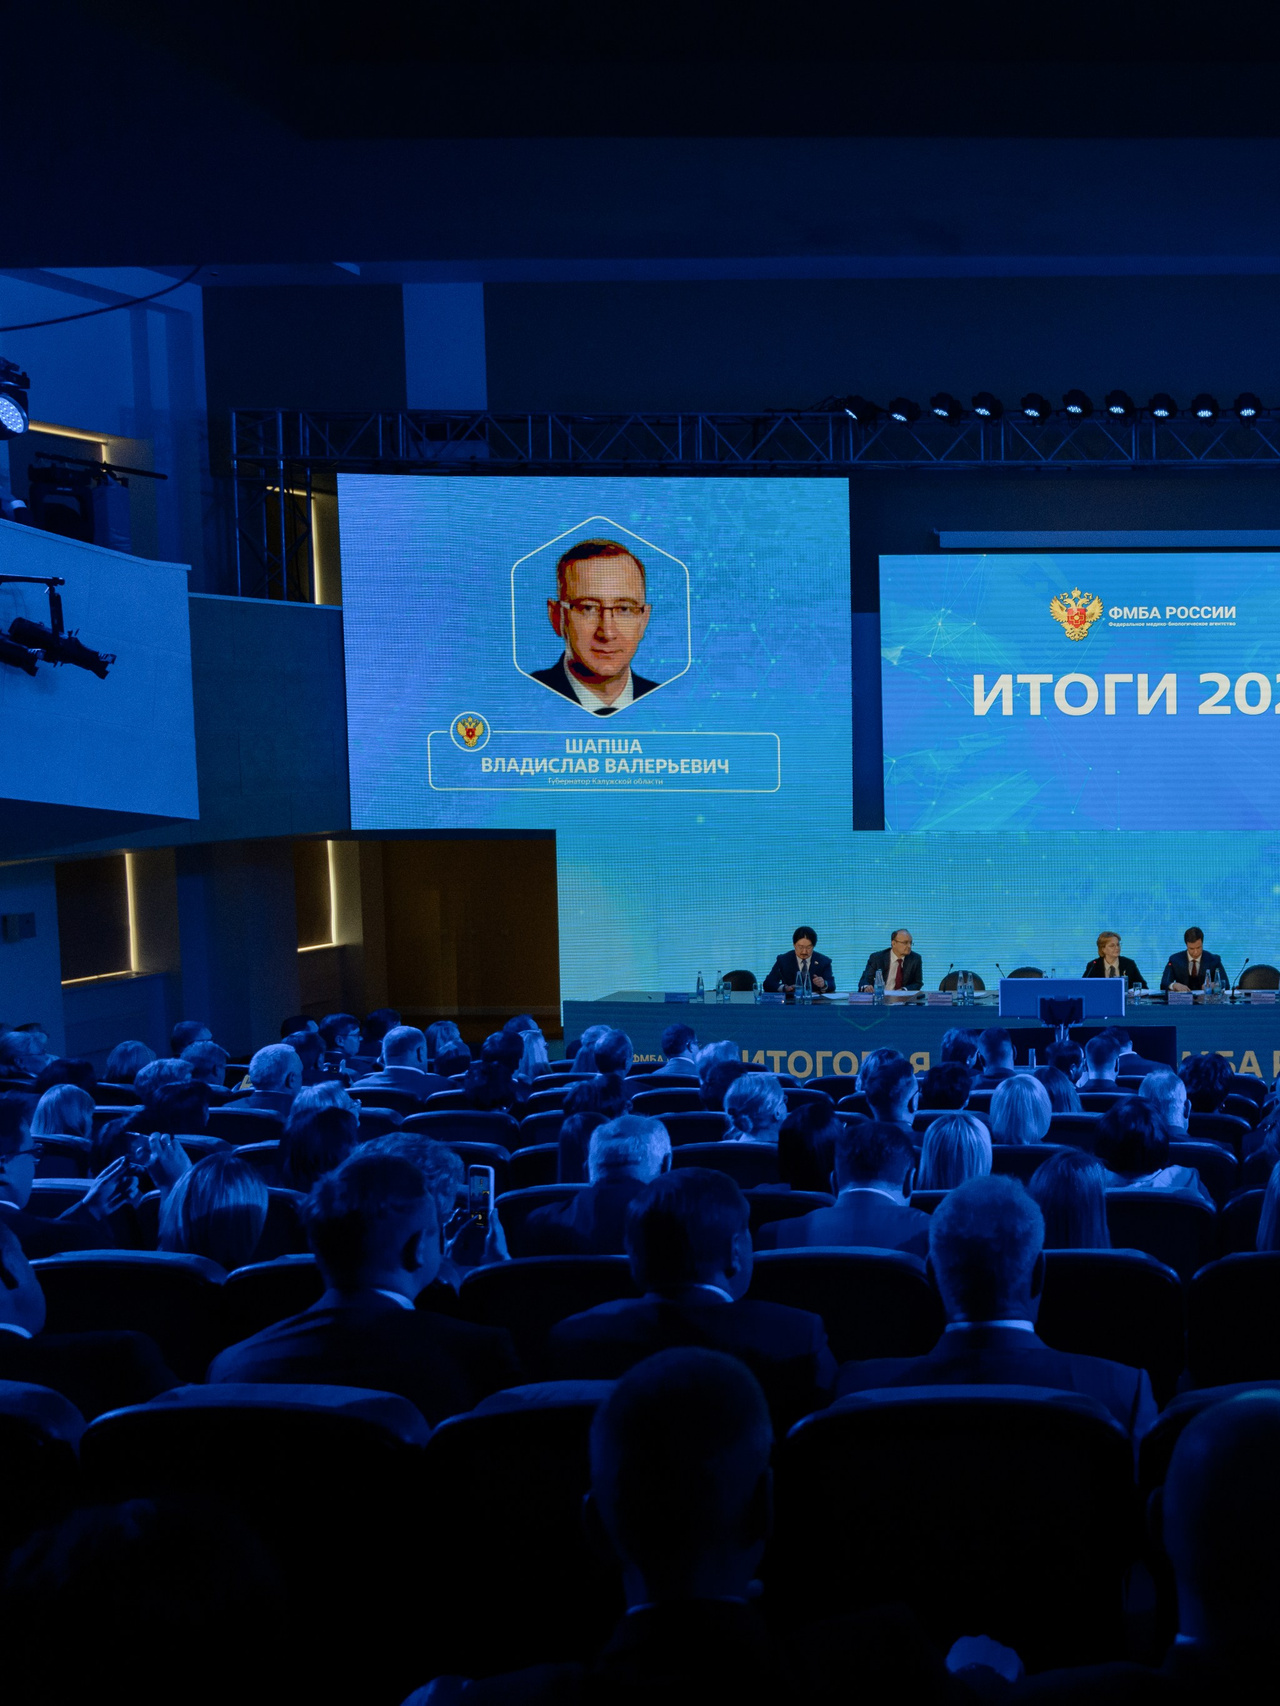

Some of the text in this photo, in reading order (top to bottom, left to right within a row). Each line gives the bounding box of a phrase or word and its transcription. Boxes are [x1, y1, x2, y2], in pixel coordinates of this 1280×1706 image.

[1108, 606, 1236, 620] ФМБА РОССИИ
[972, 672, 1178, 717] ИТОГИ
[565, 738, 643, 754] ШАПША
[481, 757, 730, 776] ВЛАДИСЛАВ ВАЛЕРЬЕВИЧ
[547, 777, 664, 786] Губернатор Калужской области
